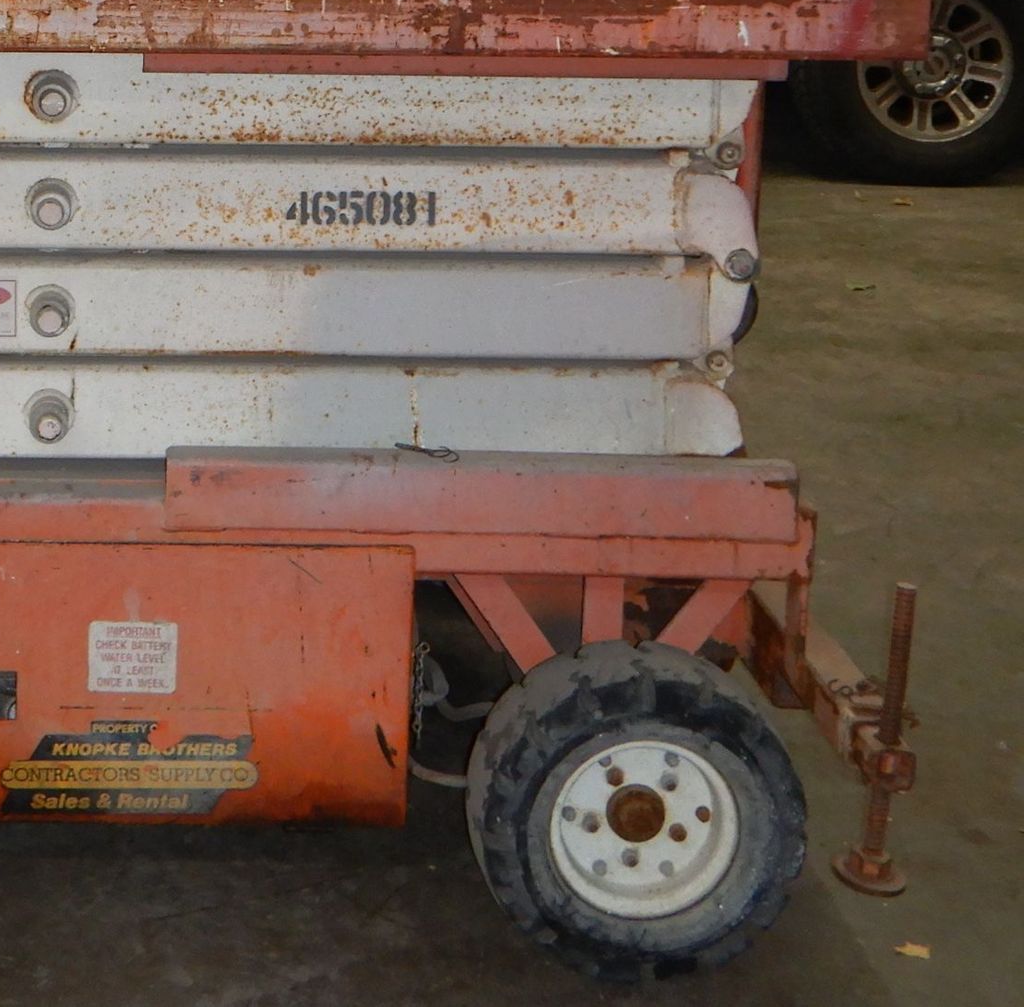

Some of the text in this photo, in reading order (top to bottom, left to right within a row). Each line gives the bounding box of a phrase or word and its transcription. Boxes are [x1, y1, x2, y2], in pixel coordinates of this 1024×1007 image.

[286, 191, 436, 226] 465081
[106, 626, 161, 639] IMPORTANT
[95, 640, 171, 651] CHECK BATTERY
[100, 652, 167, 664] WATER LEVEL
[96, 677, 122, 688] ONCE
[126, 678, 133, 688] A
[92, 723, 148, 734] PROPERTY
[52, 742, 239, 757] KNOPKE BROTHERS
[1, 766, 140, 783] CONTRACTORS
[149, 767, 217, 782] SUPPLY
[30, 793, 190, 810] Sales & Rental
